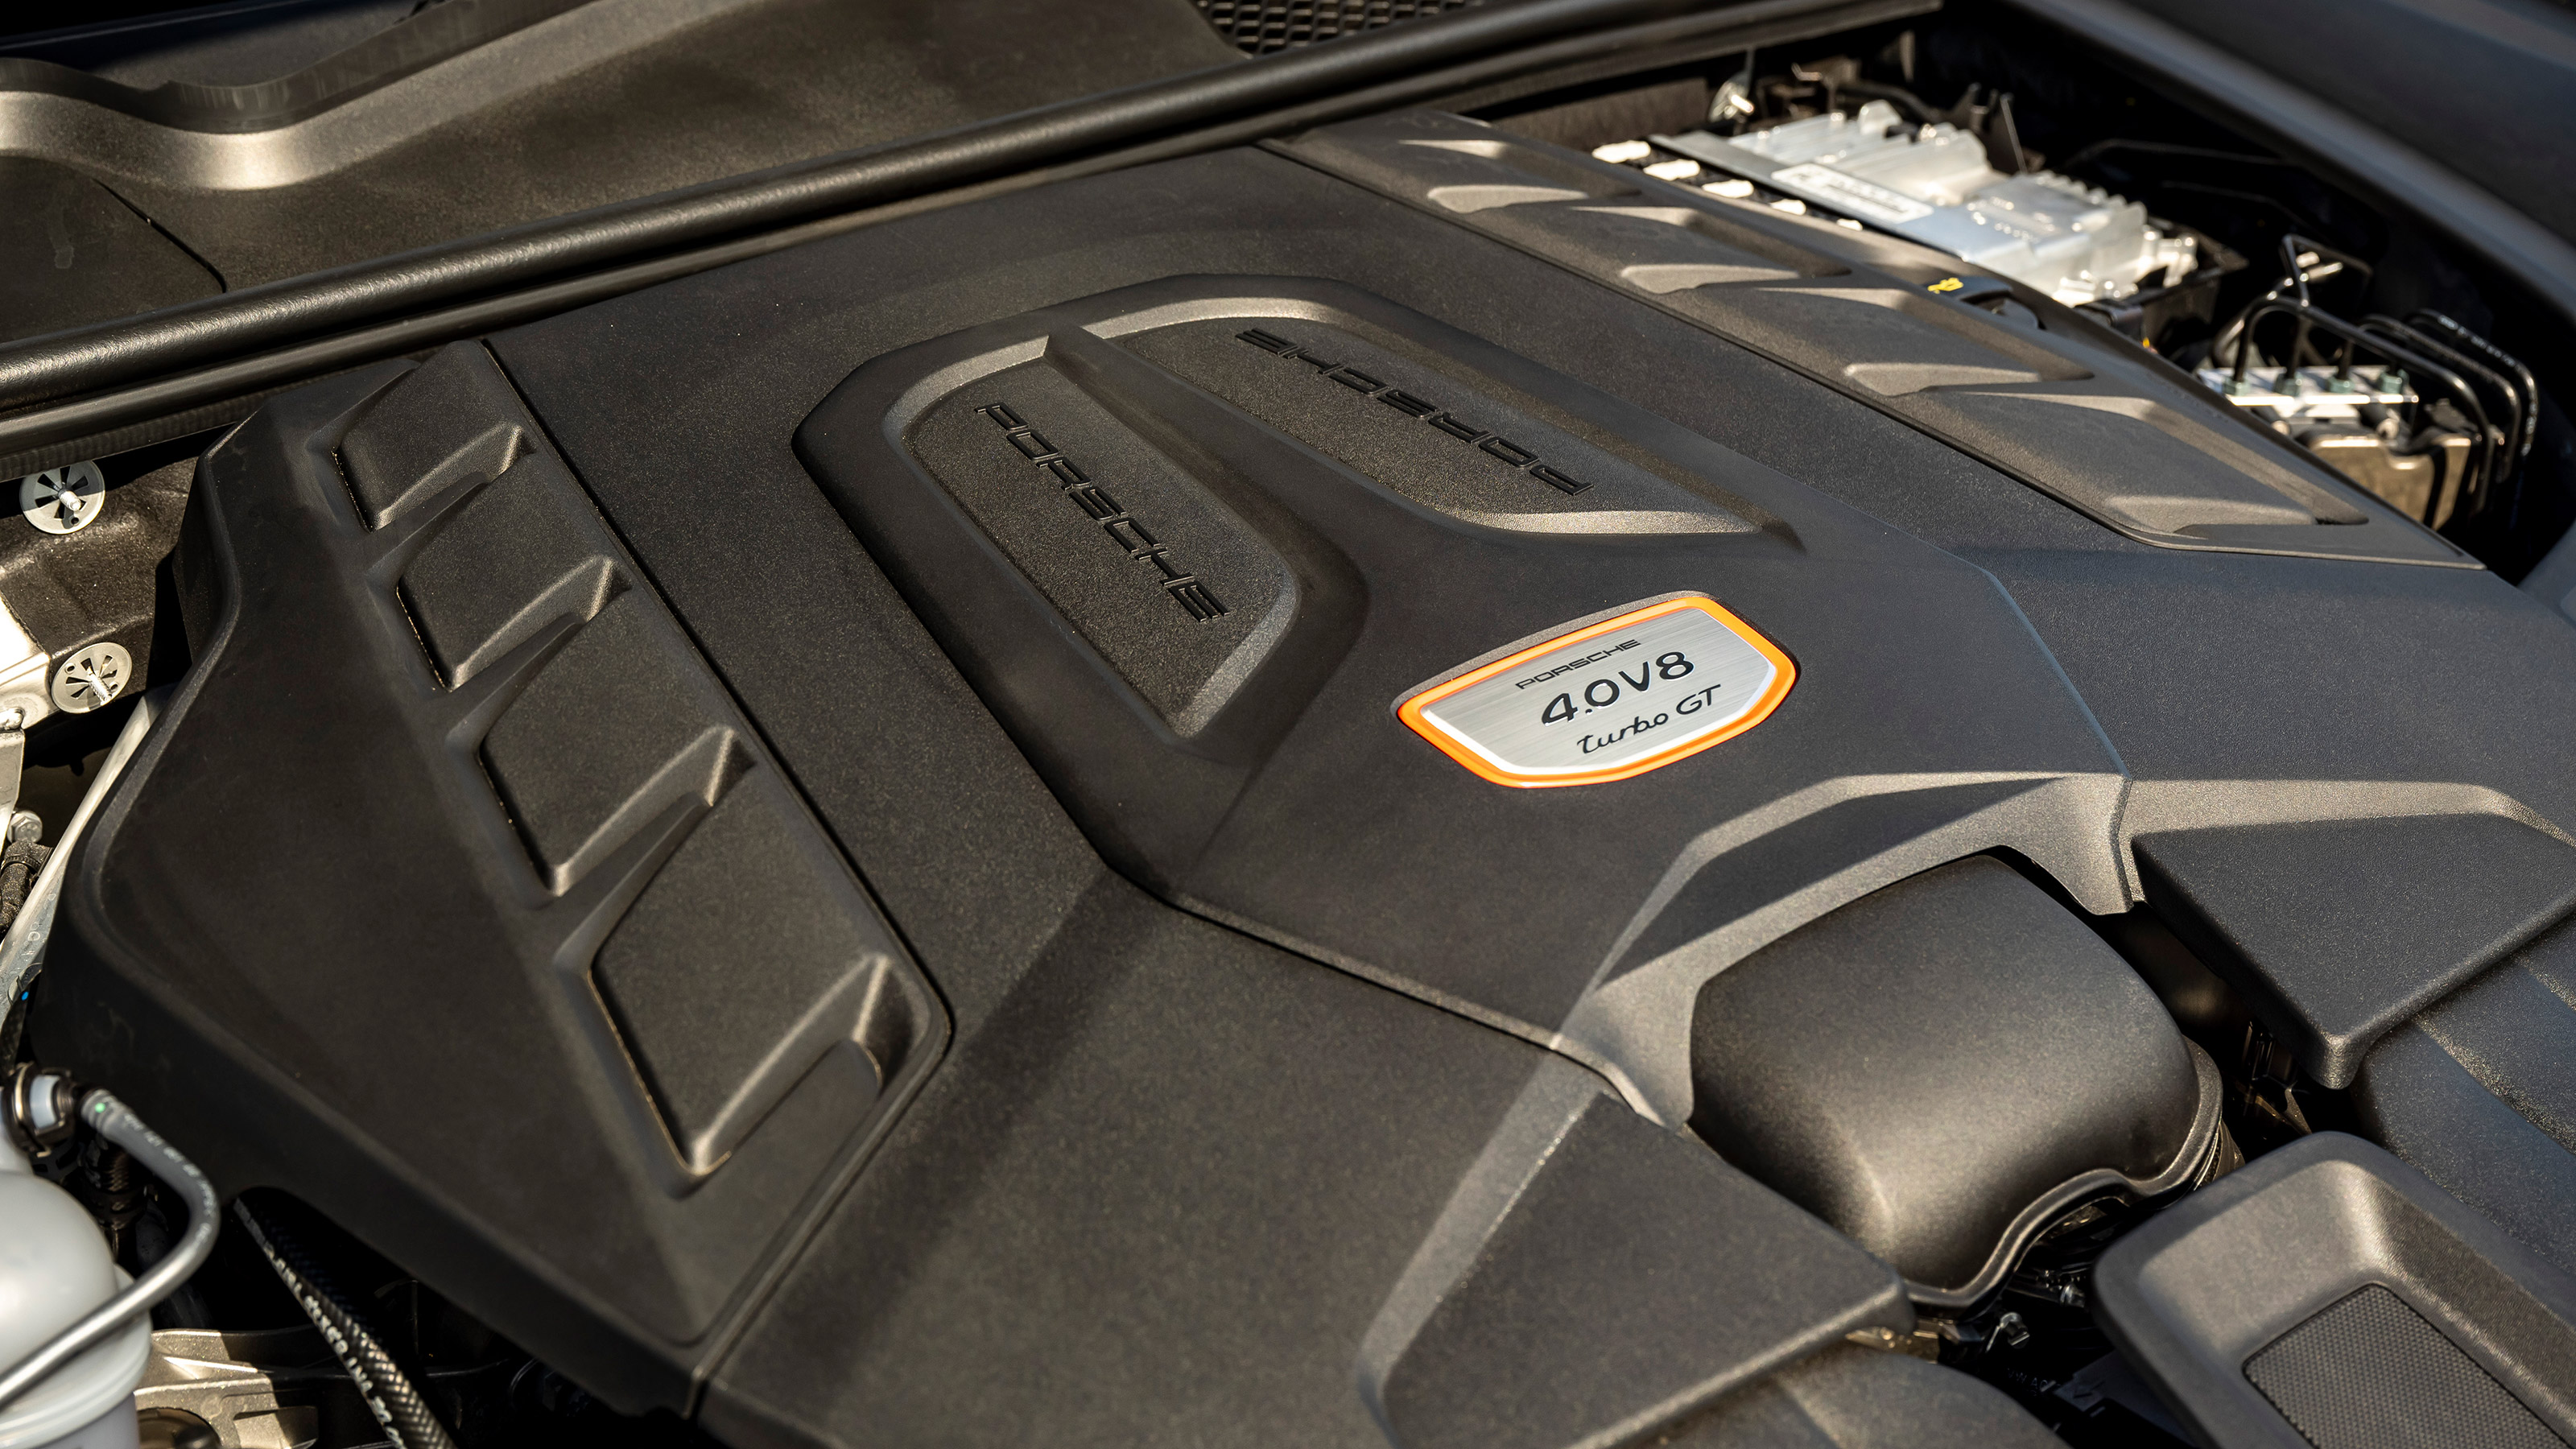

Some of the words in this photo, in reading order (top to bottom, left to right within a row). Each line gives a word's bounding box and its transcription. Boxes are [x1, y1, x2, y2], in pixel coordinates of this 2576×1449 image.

[1234, 328, 1595, 497] PORSCHE
[974, 402, 1230, 622] PORSCHE
[1515, 639, 1641, 690] PORSCHE
[1675, 683, 1722, 715] GT
